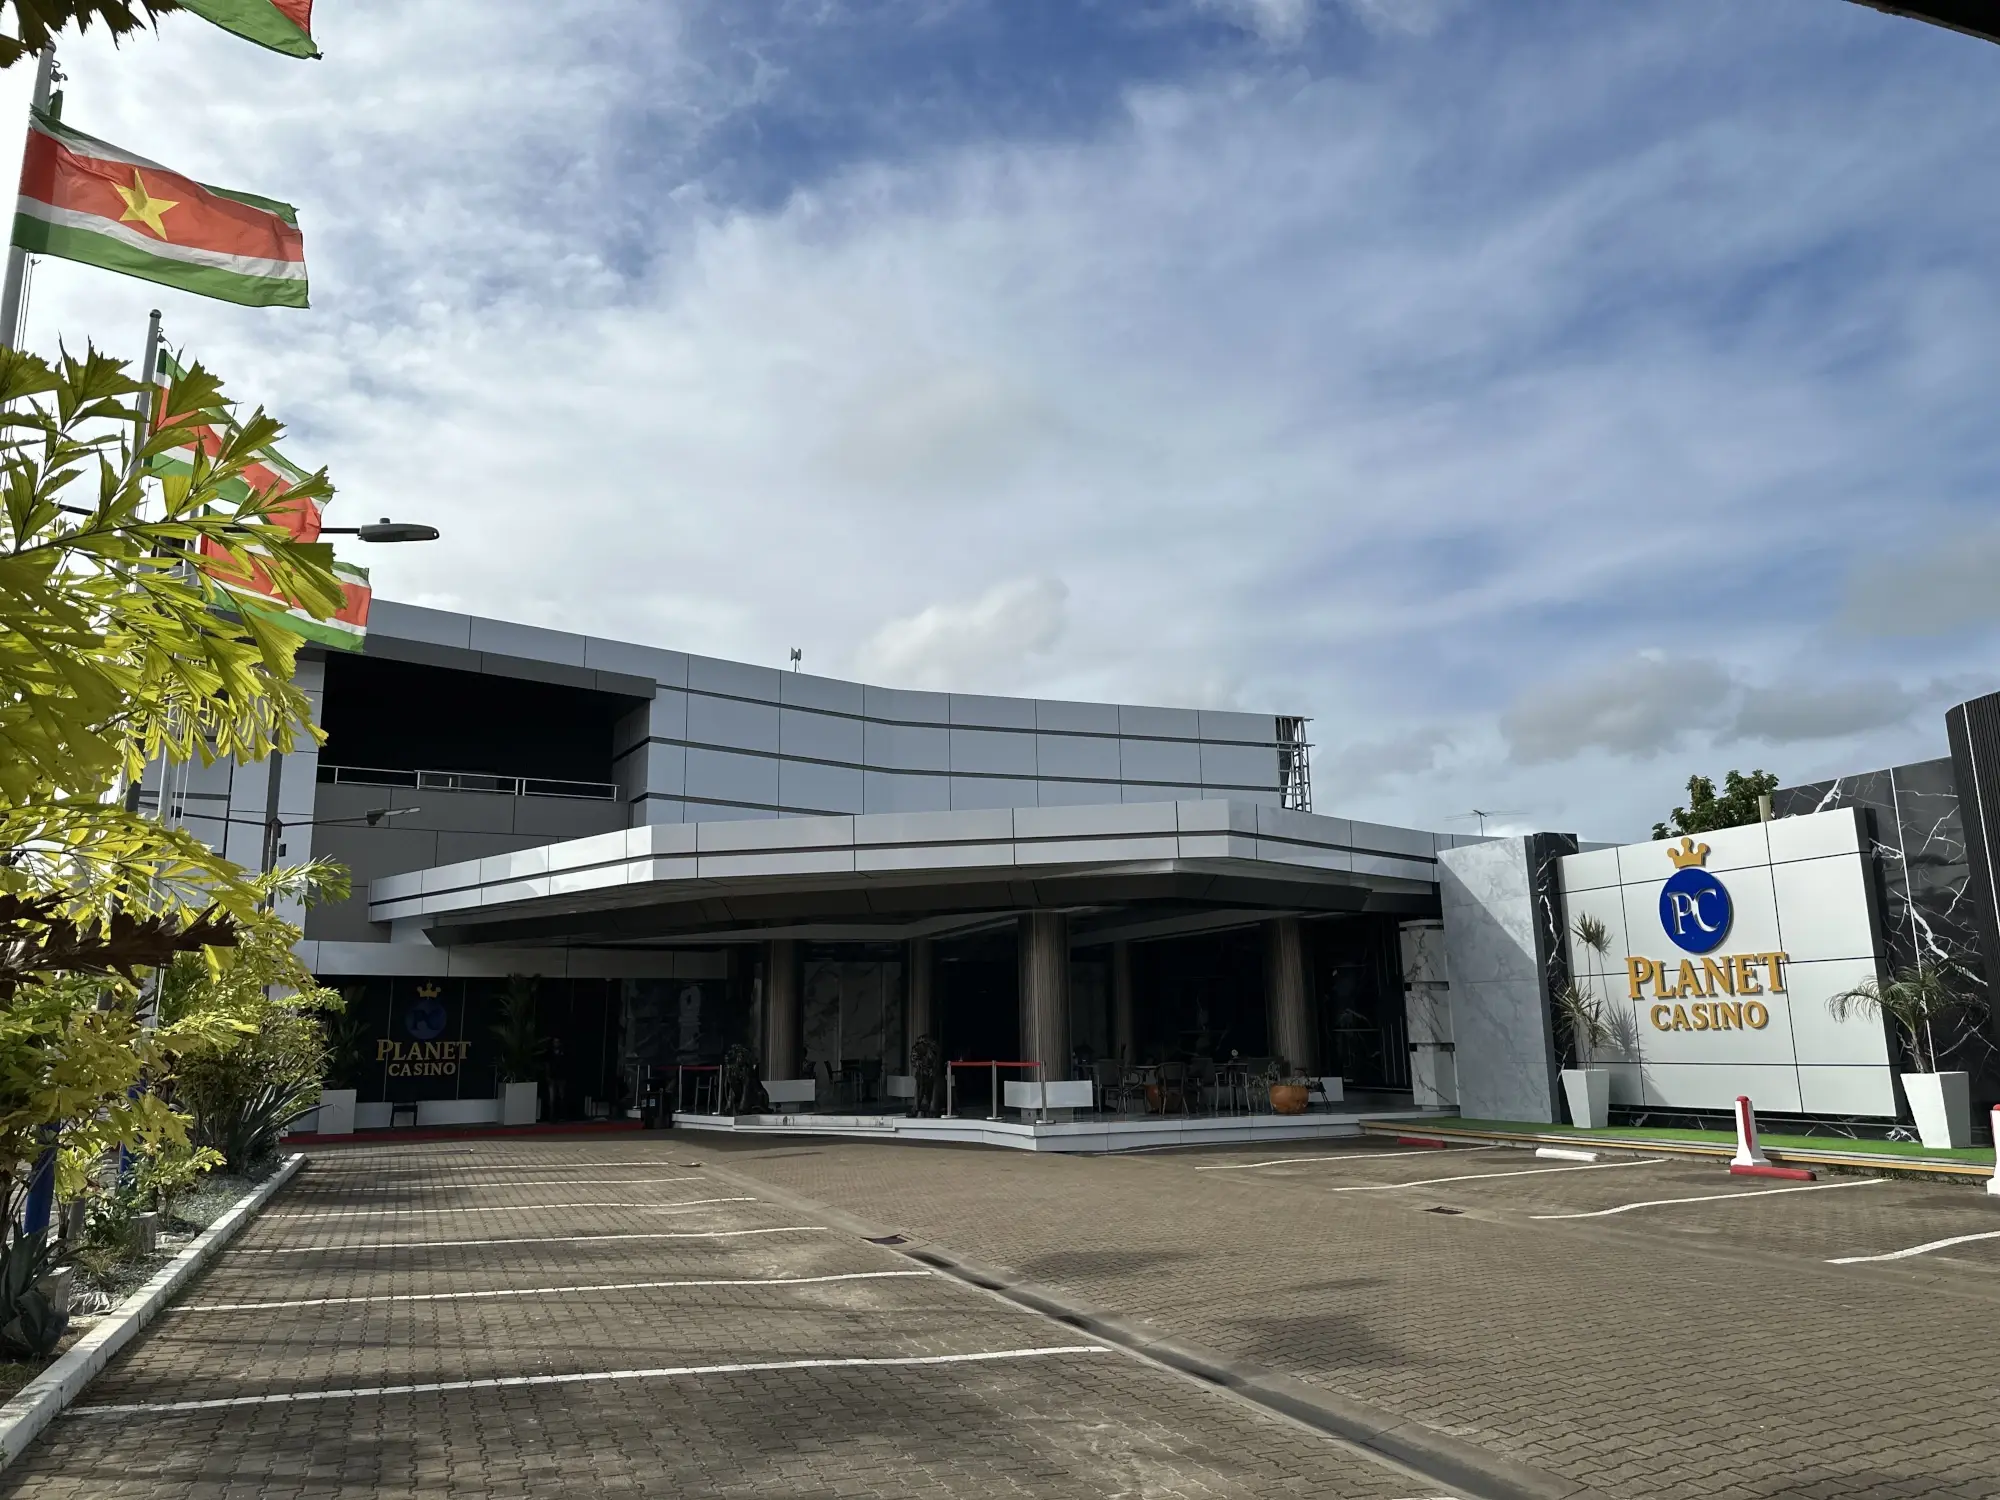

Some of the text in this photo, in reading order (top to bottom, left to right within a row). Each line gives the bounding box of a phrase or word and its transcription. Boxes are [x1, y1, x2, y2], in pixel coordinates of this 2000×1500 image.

[1667, 889, 1721, 935] PC
[1625, 952, 1788, 1000] PLANET
[1650, 1001, 1769, 1031] CASINO
[376, 1039, 472, 1061] PLANET
[388, 1062, 456, 1076] CASINO
